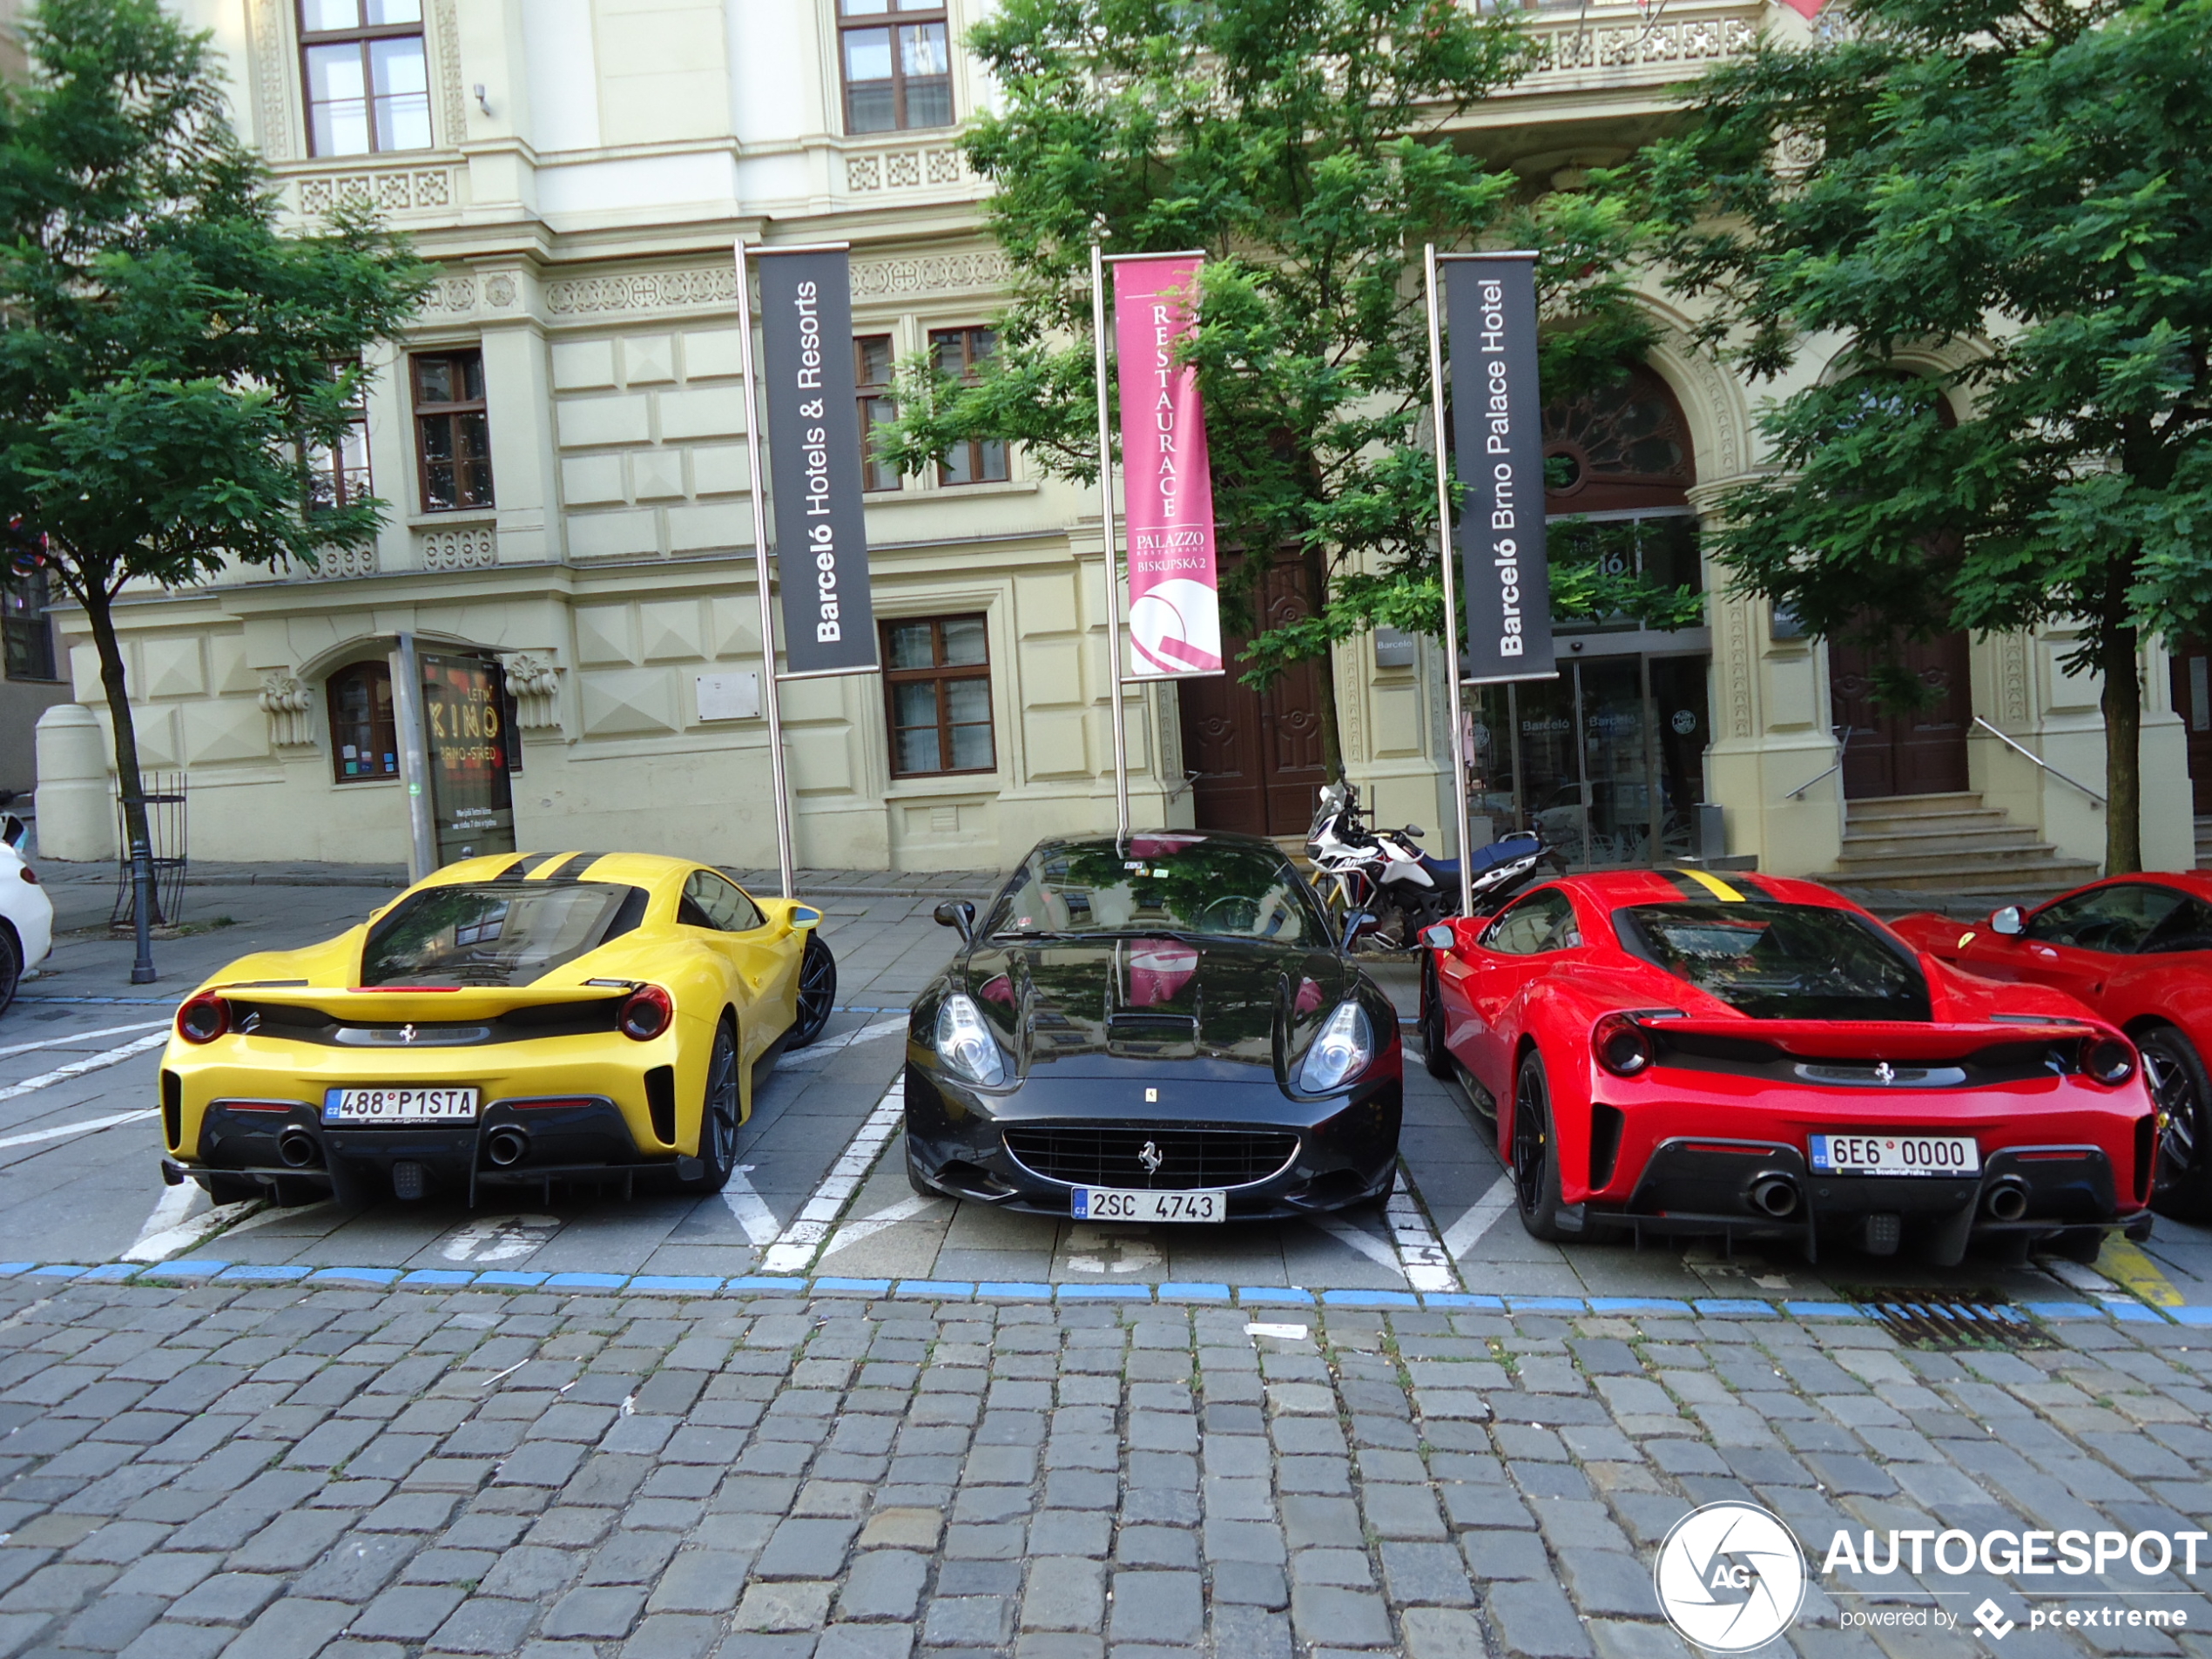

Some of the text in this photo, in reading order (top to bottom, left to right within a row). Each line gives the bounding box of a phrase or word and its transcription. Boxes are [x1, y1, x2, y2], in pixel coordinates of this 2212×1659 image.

[1153, 305, 1177, 517] RESTAURACE
[794, 280, 840, 643] Barceló Hotels & Resorts
[1478, 280, 1523, 657] Barceló Brno Palace Hotel
[1136, 531, 1204, 550] PALAZZO
[1136, 547, 1204, 556] RESTAURANT
[1137, 556, 1206, 573] BISKUPSKÁ 2
[428, 703, 498, 738] KINO
[1522, 718, 1570, 732] Barceló
[327, 1091, 471, 1116] CZ 488 P1STA
[1813, 1138, 1966, 1166] CZ 6E6 0000
[1093, 1193, 1136, 1217] 2SC
[1155, 1196, 1213, 1218] 4743
